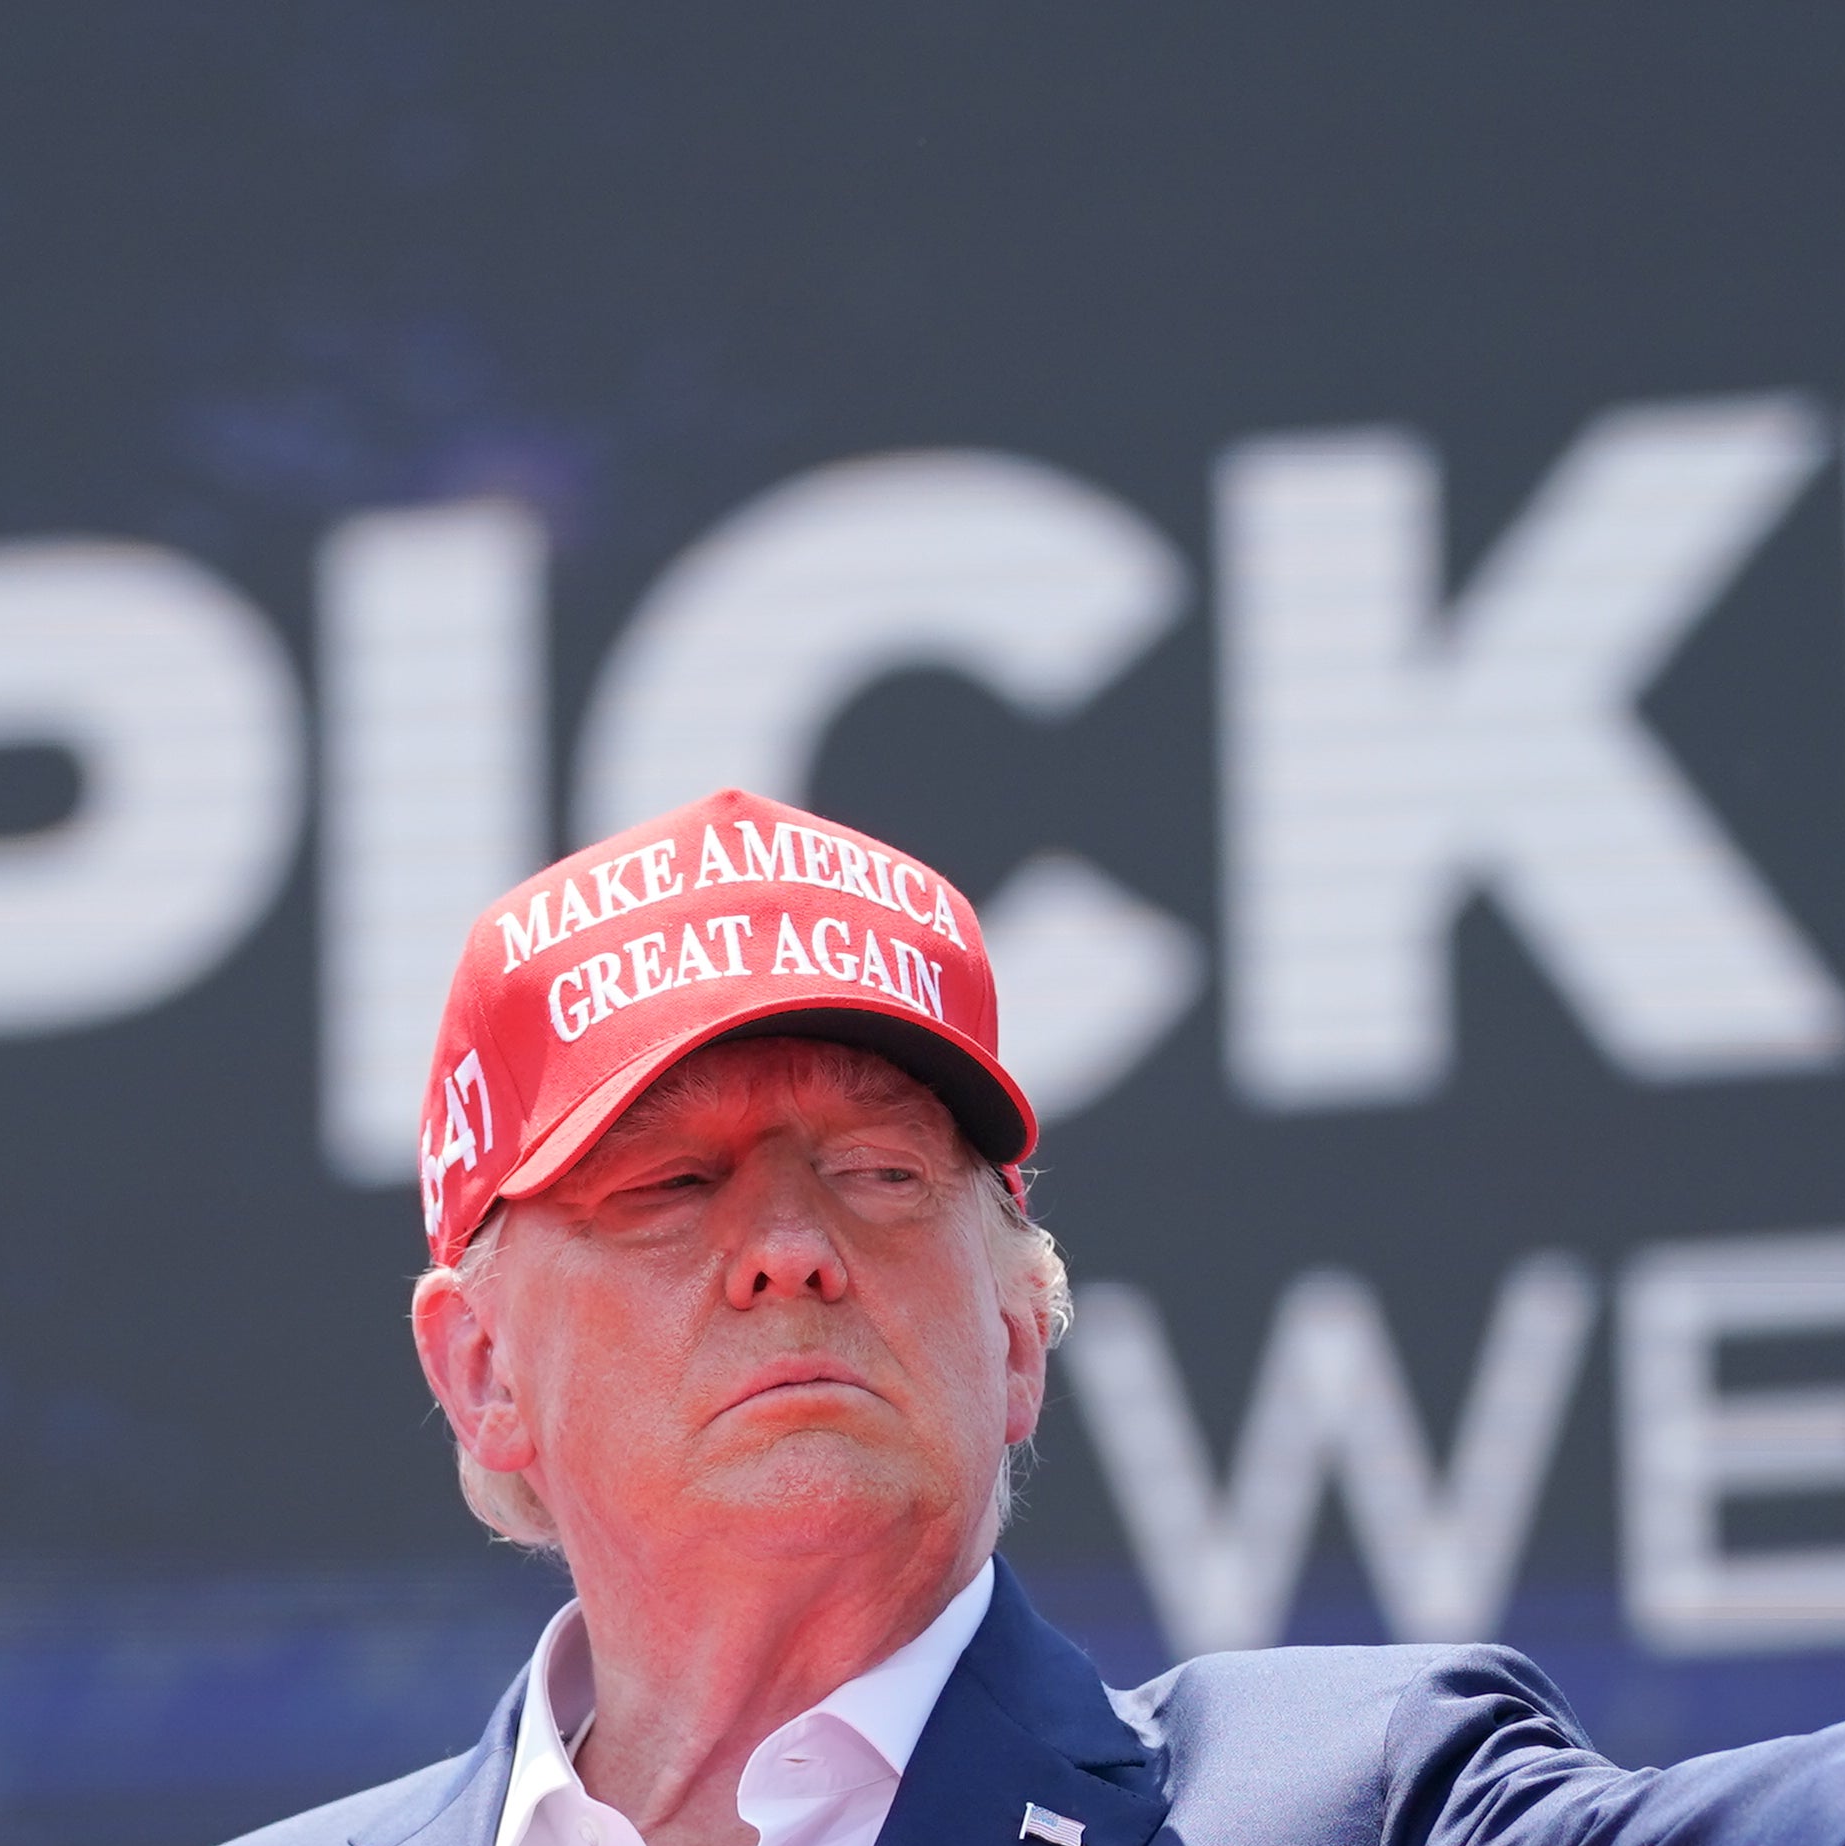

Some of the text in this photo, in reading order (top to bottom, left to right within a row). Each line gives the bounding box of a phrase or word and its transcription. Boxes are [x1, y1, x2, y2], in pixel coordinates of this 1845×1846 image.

[496, 820, 967, 974] MAKE AMERICA
[548, 912, 944, 1043] GREAT AGAIN
